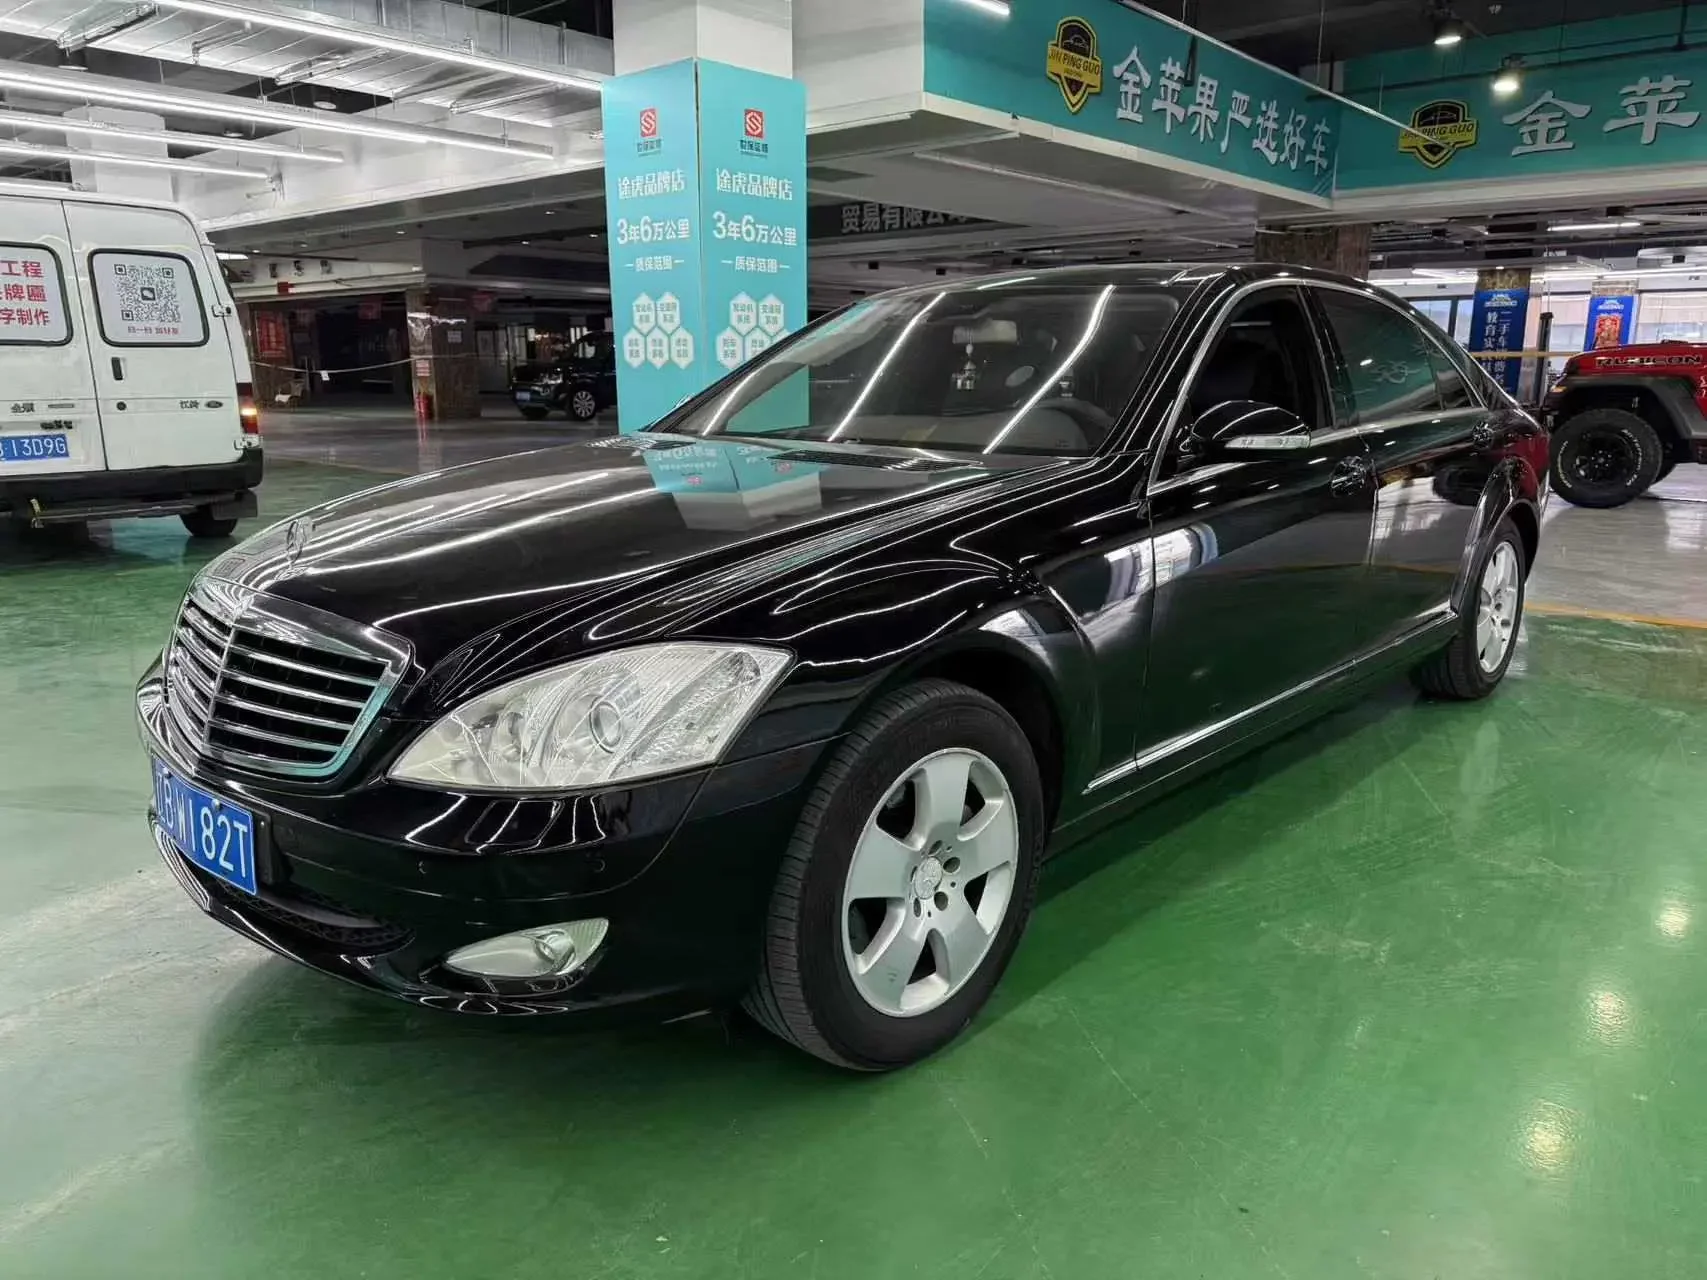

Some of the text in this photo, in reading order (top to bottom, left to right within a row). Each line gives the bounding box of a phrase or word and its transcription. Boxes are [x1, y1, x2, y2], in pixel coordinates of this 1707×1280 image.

[1063, 54, 1082, 69] PING
[1082, 60, 1100, 75] GUO
[1112, 45, 1331, 175] 金苹果严选好车
[1449, 123, 1474, 134] GUO
[618, 167, 685, 200] 途虎品牌店
[715, 166, 793, 202] 途虎品牌店
[617, 216, 690, 246] 3年6万公里
[712, 211, 797, 247] 3年6万公里
[0, 260, 44, 278] 工程
[635, 256, 673, 272] 质保范围
[735, 255, 778, 273] 质保范围
[0, 283, 47, 302] 牌匾
[1596, 354, 1703, 369] RUBICON
